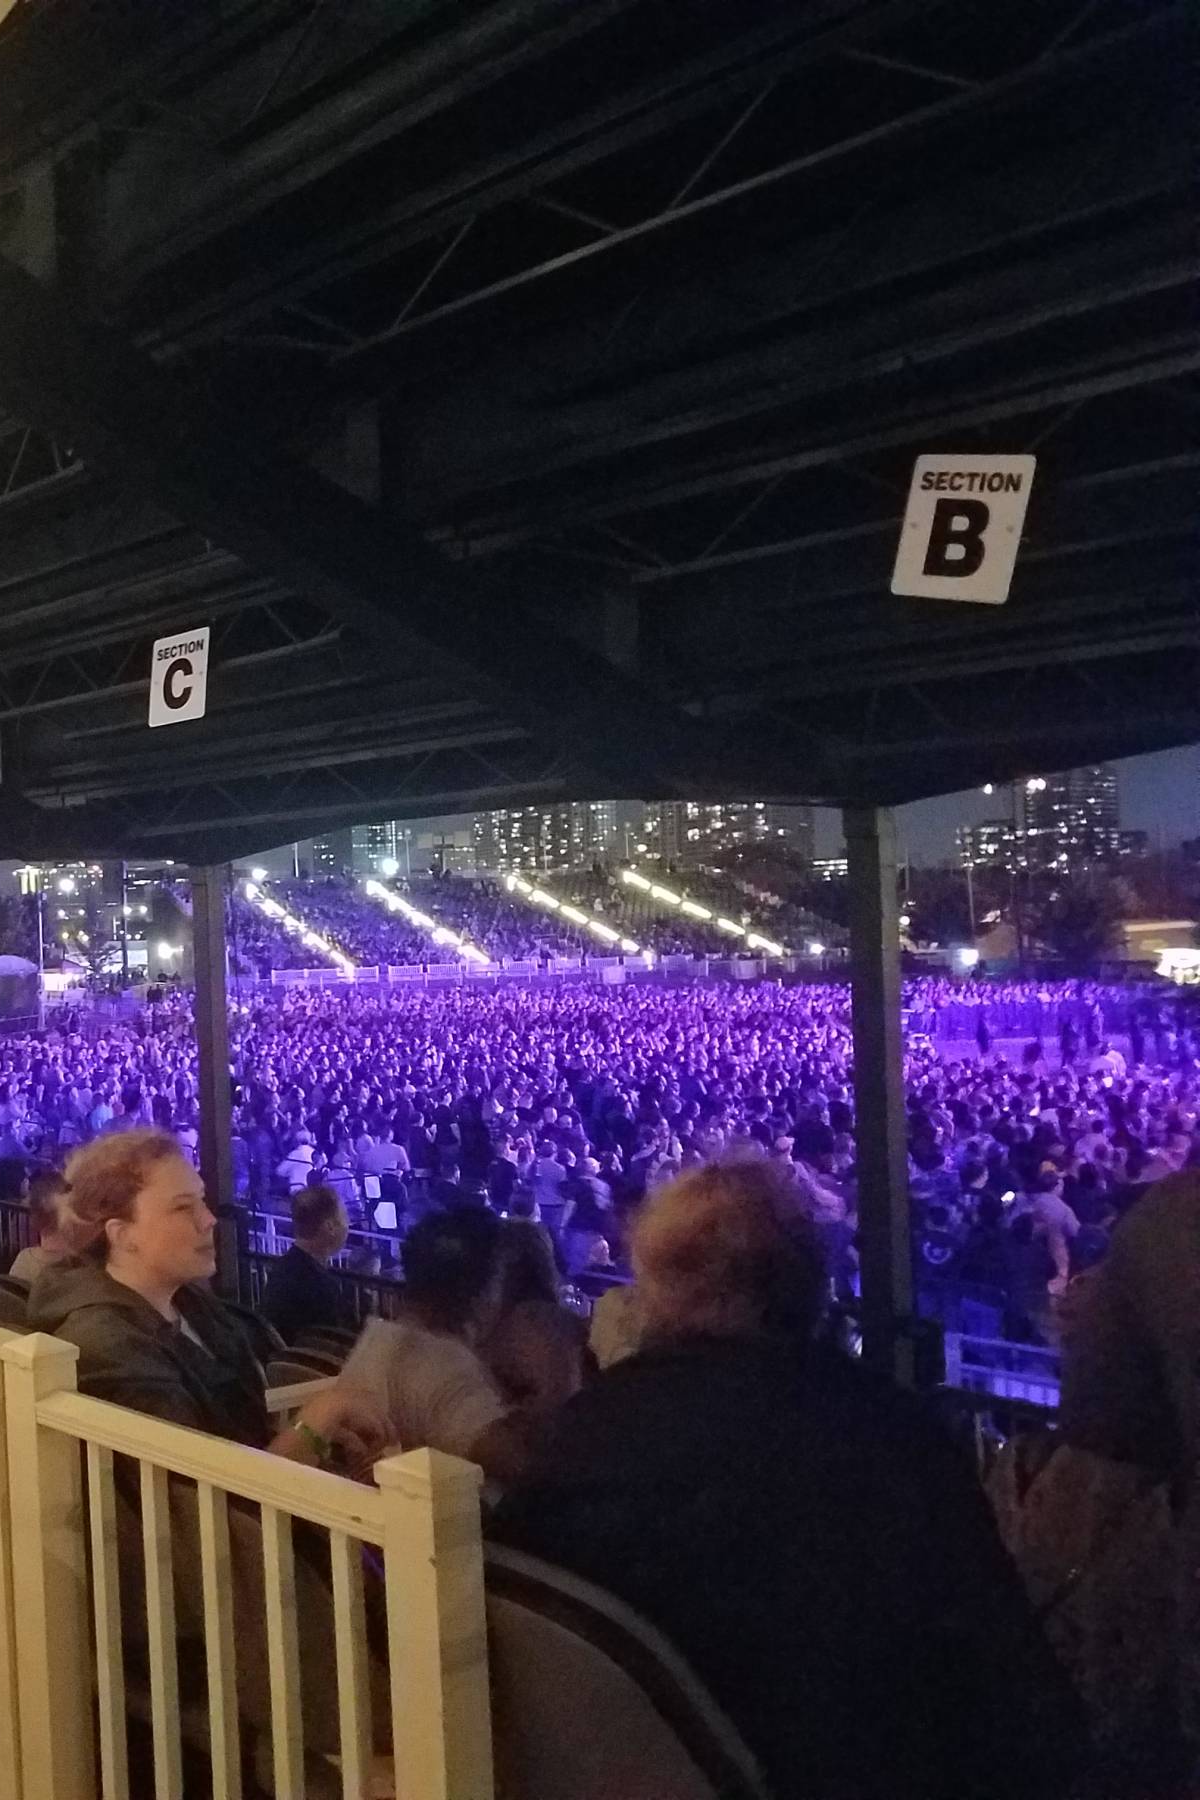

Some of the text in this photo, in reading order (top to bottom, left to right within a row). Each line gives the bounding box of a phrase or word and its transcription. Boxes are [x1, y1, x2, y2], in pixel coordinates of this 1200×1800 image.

[920, 471, 1023, 493] SECTION
[922, 498, 990, 577] B
[157, 639, 204, 661] SECTION
[163, 657, 193, 710] C
